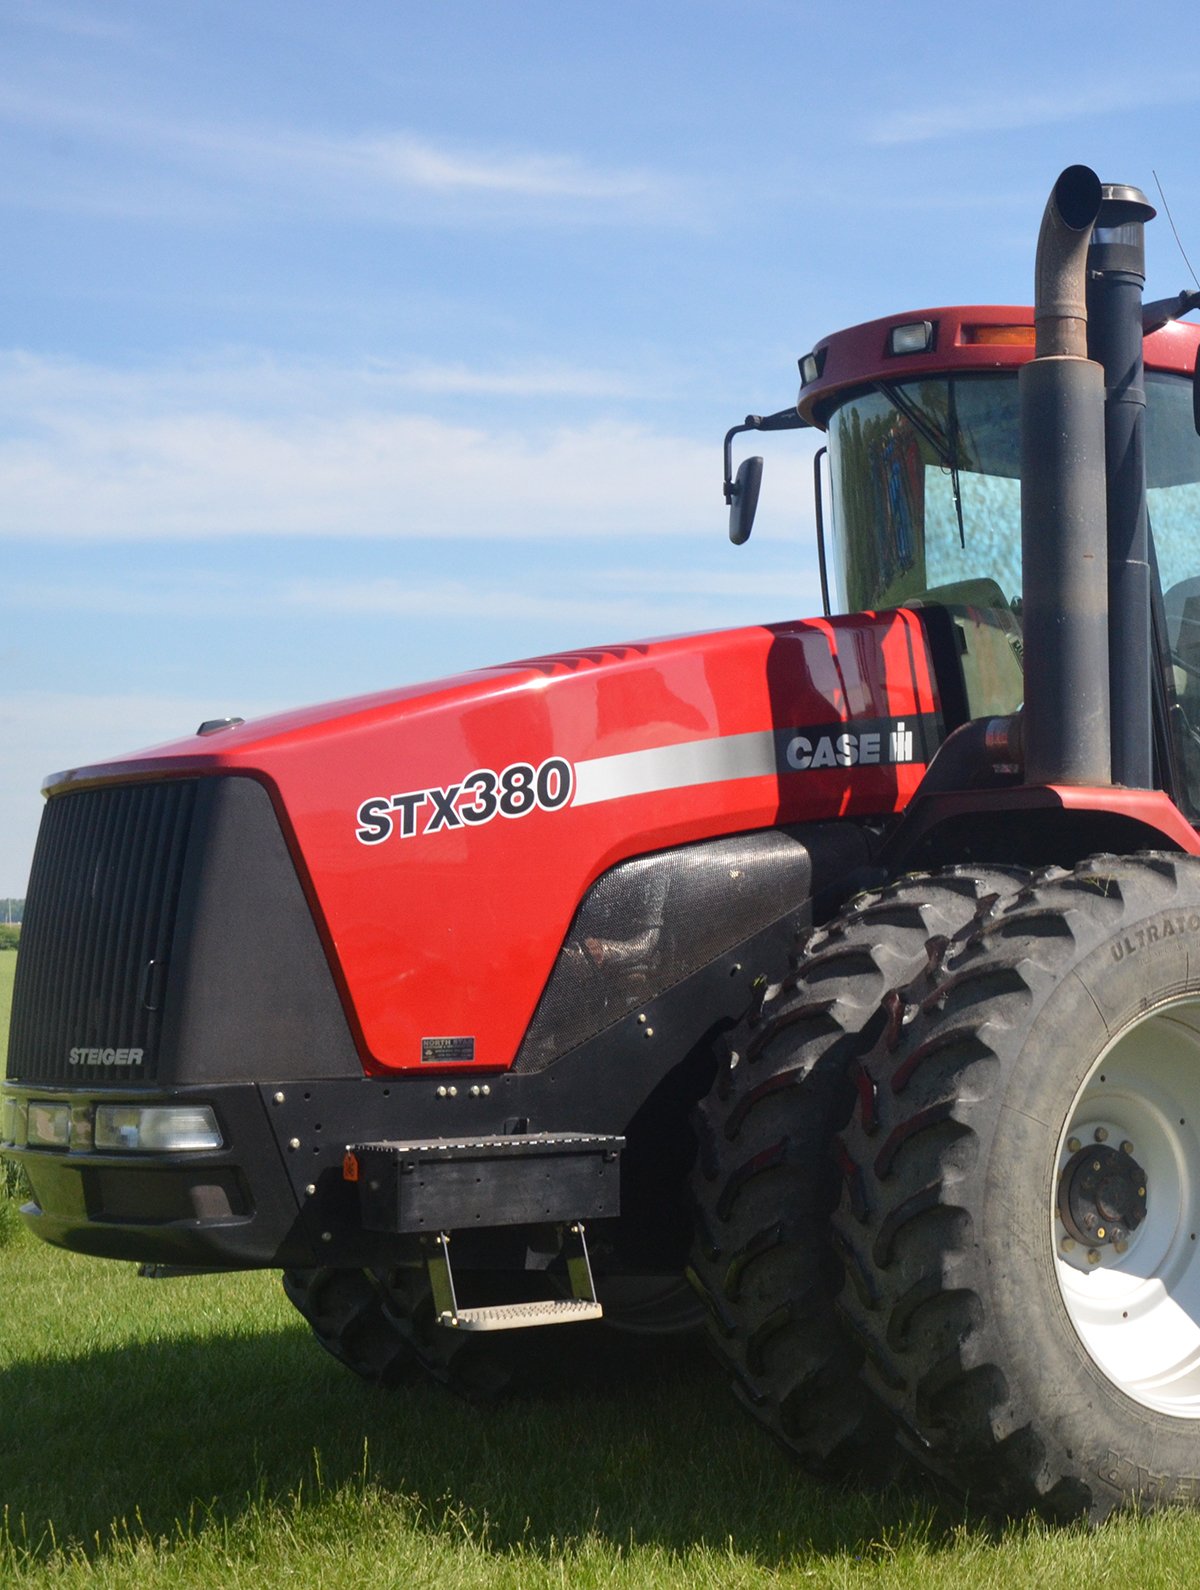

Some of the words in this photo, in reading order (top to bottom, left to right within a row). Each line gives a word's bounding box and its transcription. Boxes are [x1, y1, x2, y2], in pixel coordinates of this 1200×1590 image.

[786, 733, 880, 769] CASE
[356, 756, 573, 845] STX380
[69, 1047, 144, 1065] STEIGER
